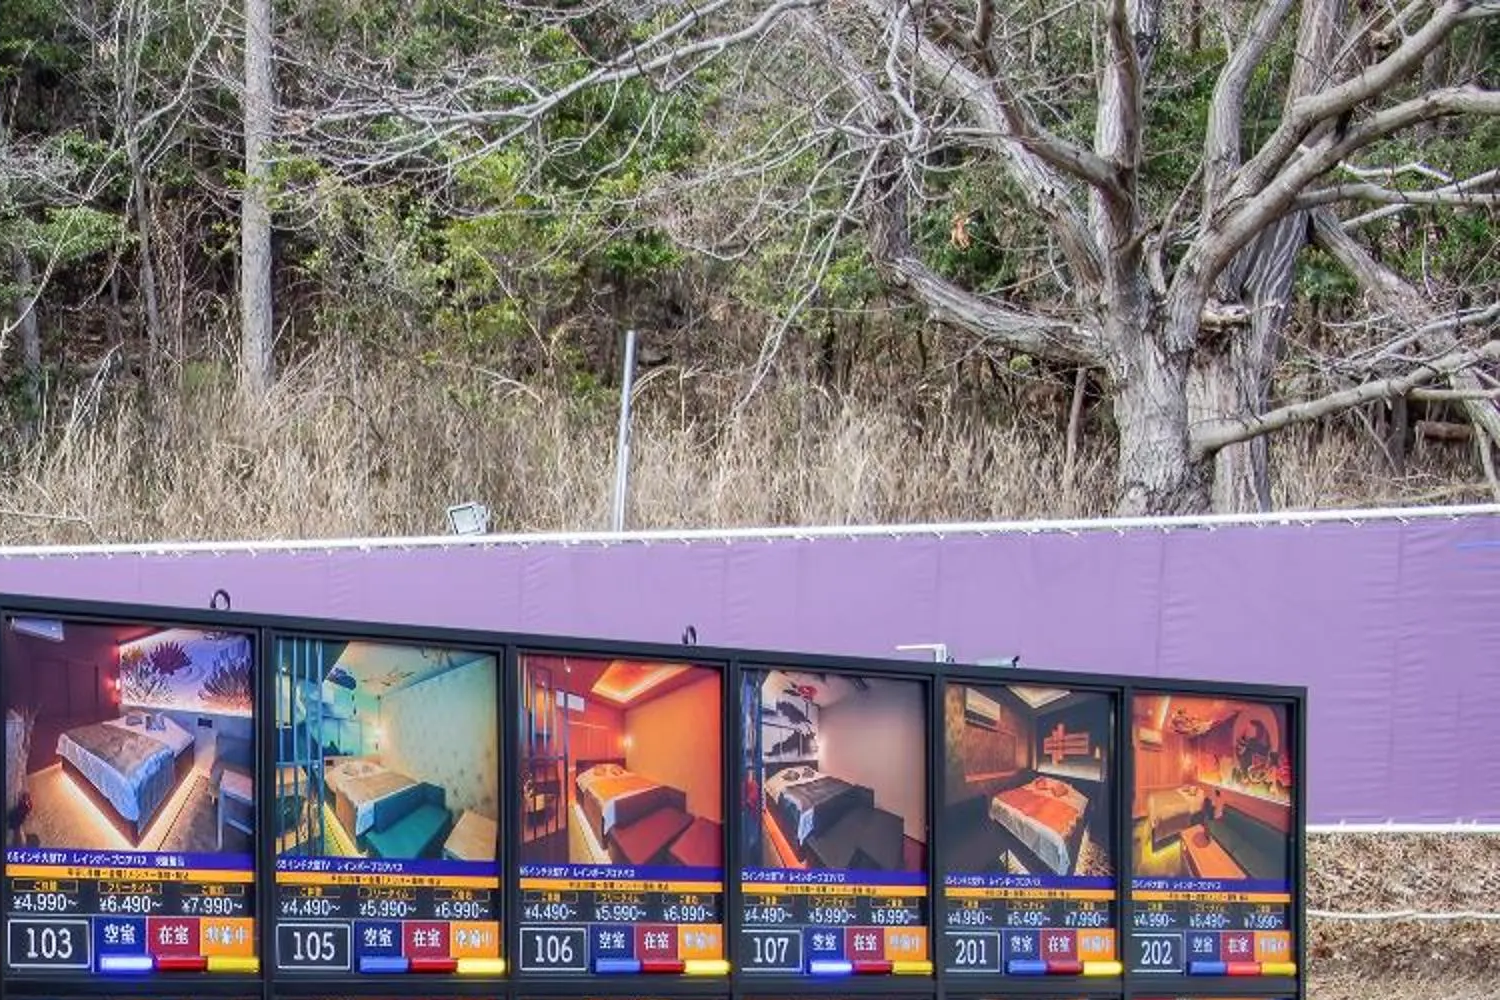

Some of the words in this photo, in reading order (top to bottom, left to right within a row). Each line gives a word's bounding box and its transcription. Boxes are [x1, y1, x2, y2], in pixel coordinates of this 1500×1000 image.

[27, 928, 72, 959] 103
[104, 925, 135, 944] 空室
[158, 925, 189, 945] 在室
[293, 932, 335, 961] 105
[535, 935, 573, 963] 106
[754, 937, 788, 963] 107
[956, 939, 986, 964] 201
[1141, 941, 1172, 965] 202
